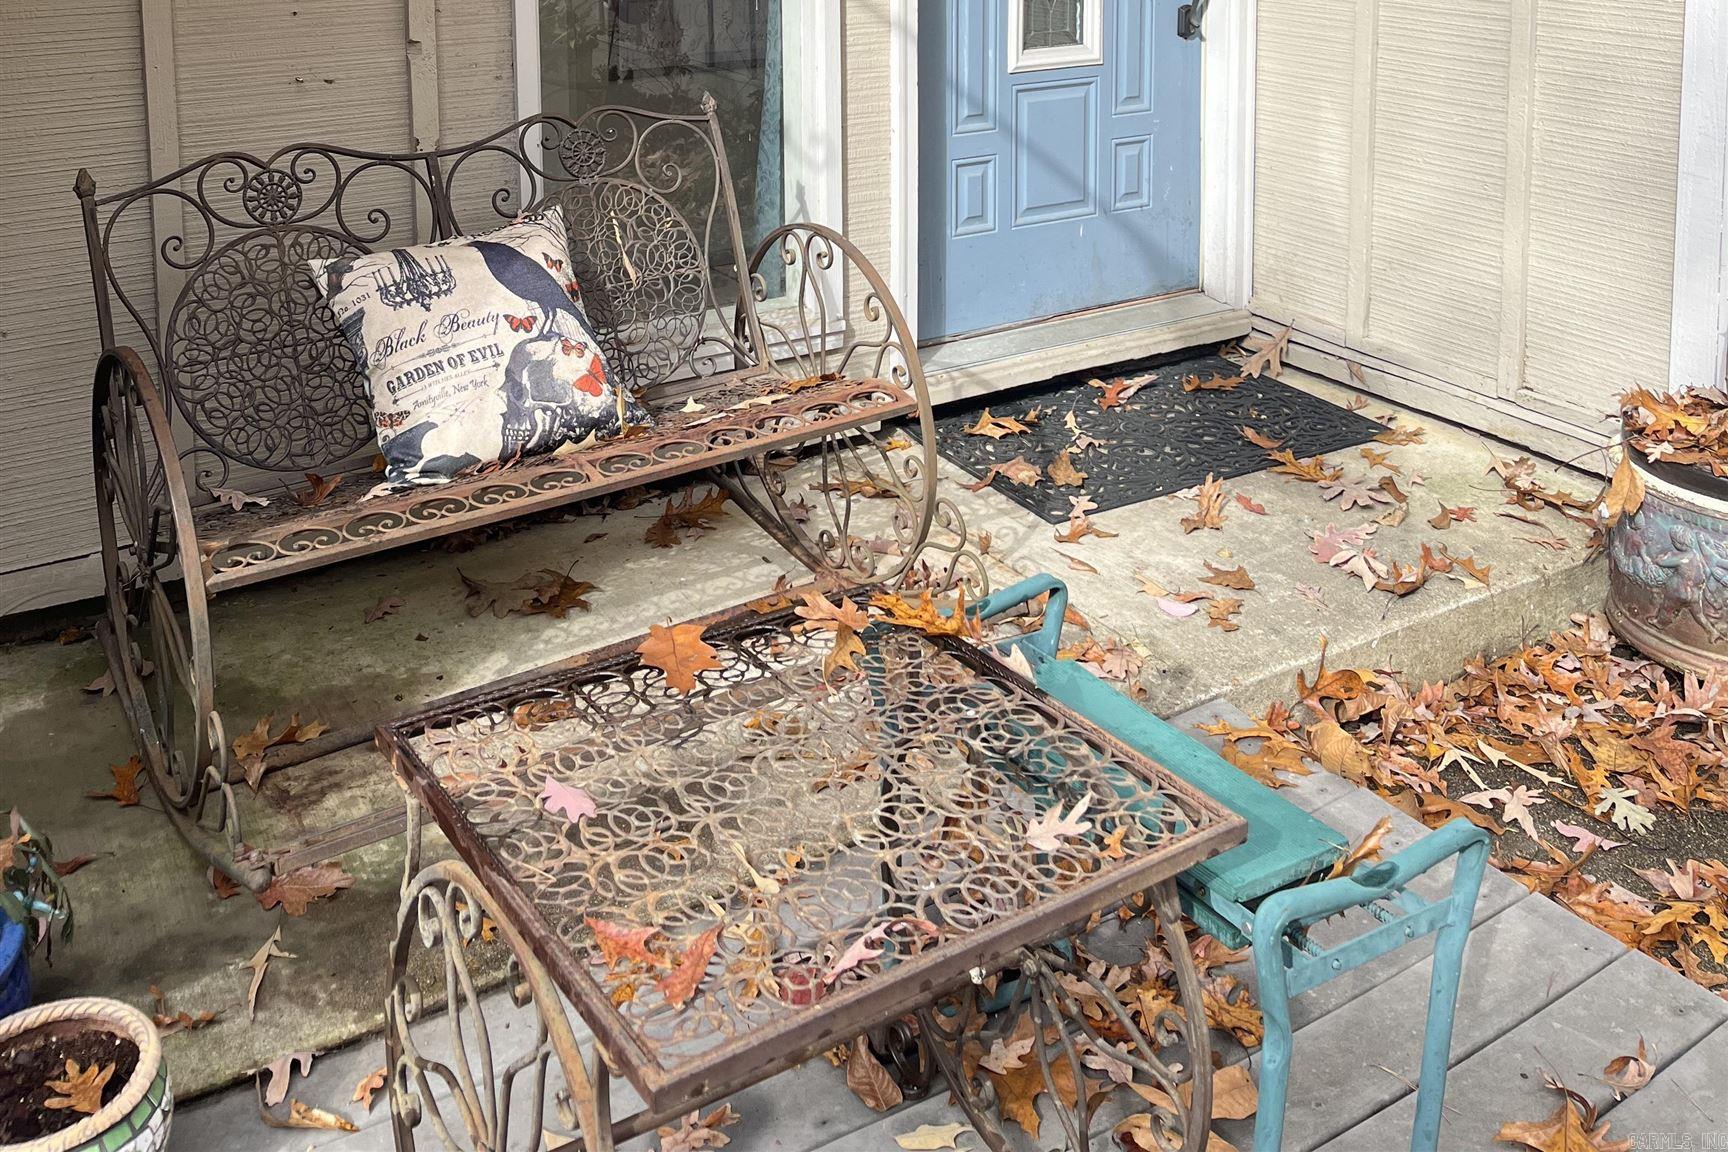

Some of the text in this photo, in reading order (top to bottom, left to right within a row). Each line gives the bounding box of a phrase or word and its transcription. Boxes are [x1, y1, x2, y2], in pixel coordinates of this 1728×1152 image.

[351, 291, 371, 307] 1031
[369, 308, 500, 371] Black Beauty
[386, 343, 505, 396] GARDEN OF EVIL
[452, 383, 469, 395] New
[468, 374, 490, 392] York
